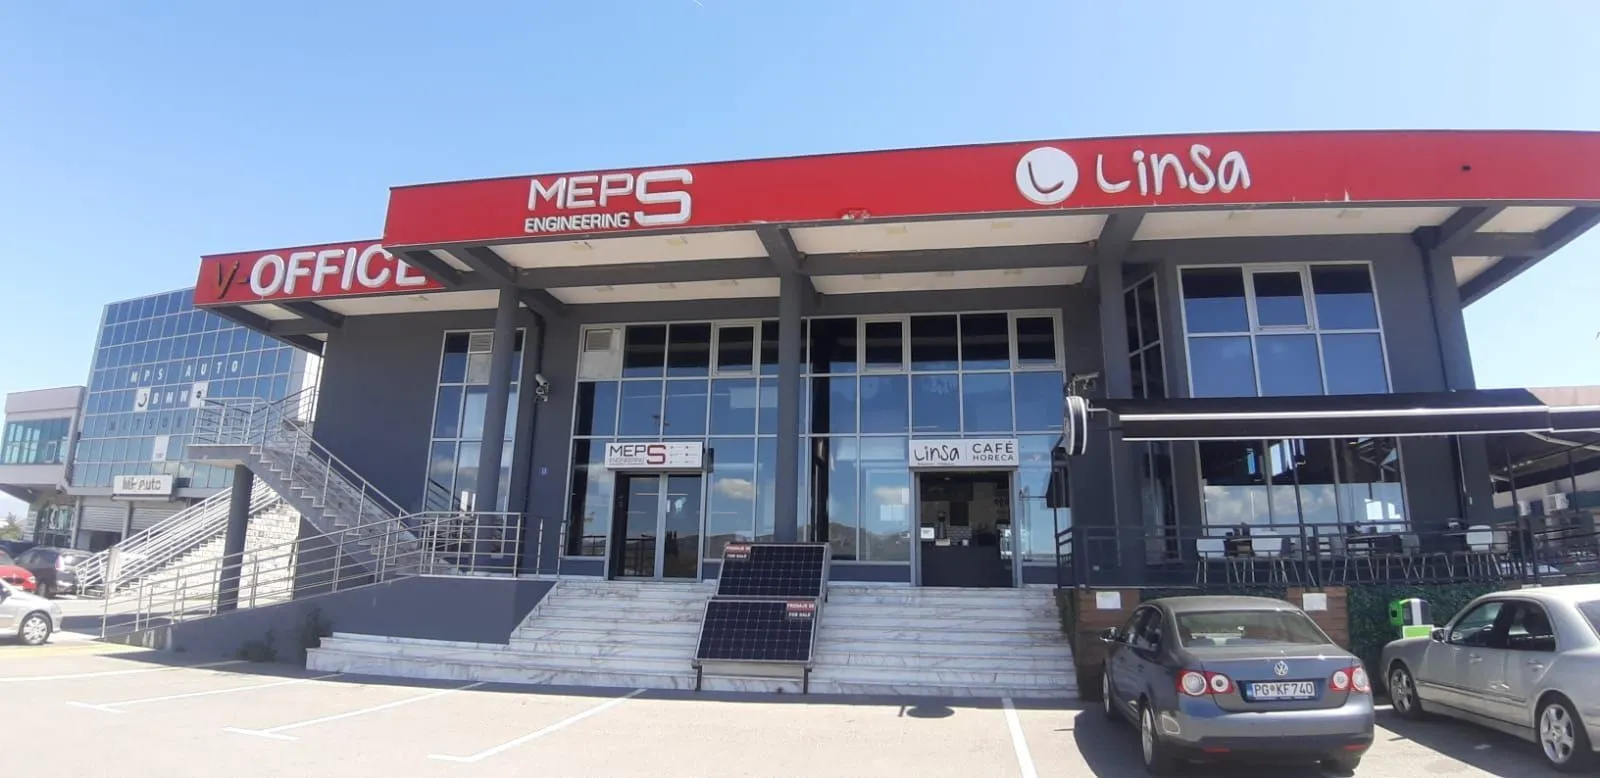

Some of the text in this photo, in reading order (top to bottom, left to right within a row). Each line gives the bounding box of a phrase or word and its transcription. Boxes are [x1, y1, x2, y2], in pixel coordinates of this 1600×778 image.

[527, 168, 693, 227] MEPS
[524, 211, 632, 233] ENGINEERING
[130, 360, 239, 383] MPS AUTO
[152, 390, 189, 405] BMW
[609, 444, 667, 465] MEPS
[972, 440, 1015, 454] CAFÉ
[972, 454, 1014, 462] HORECA
[138, 477, 161, 491] Auto
[1255, 684, 1270, 696] PG
